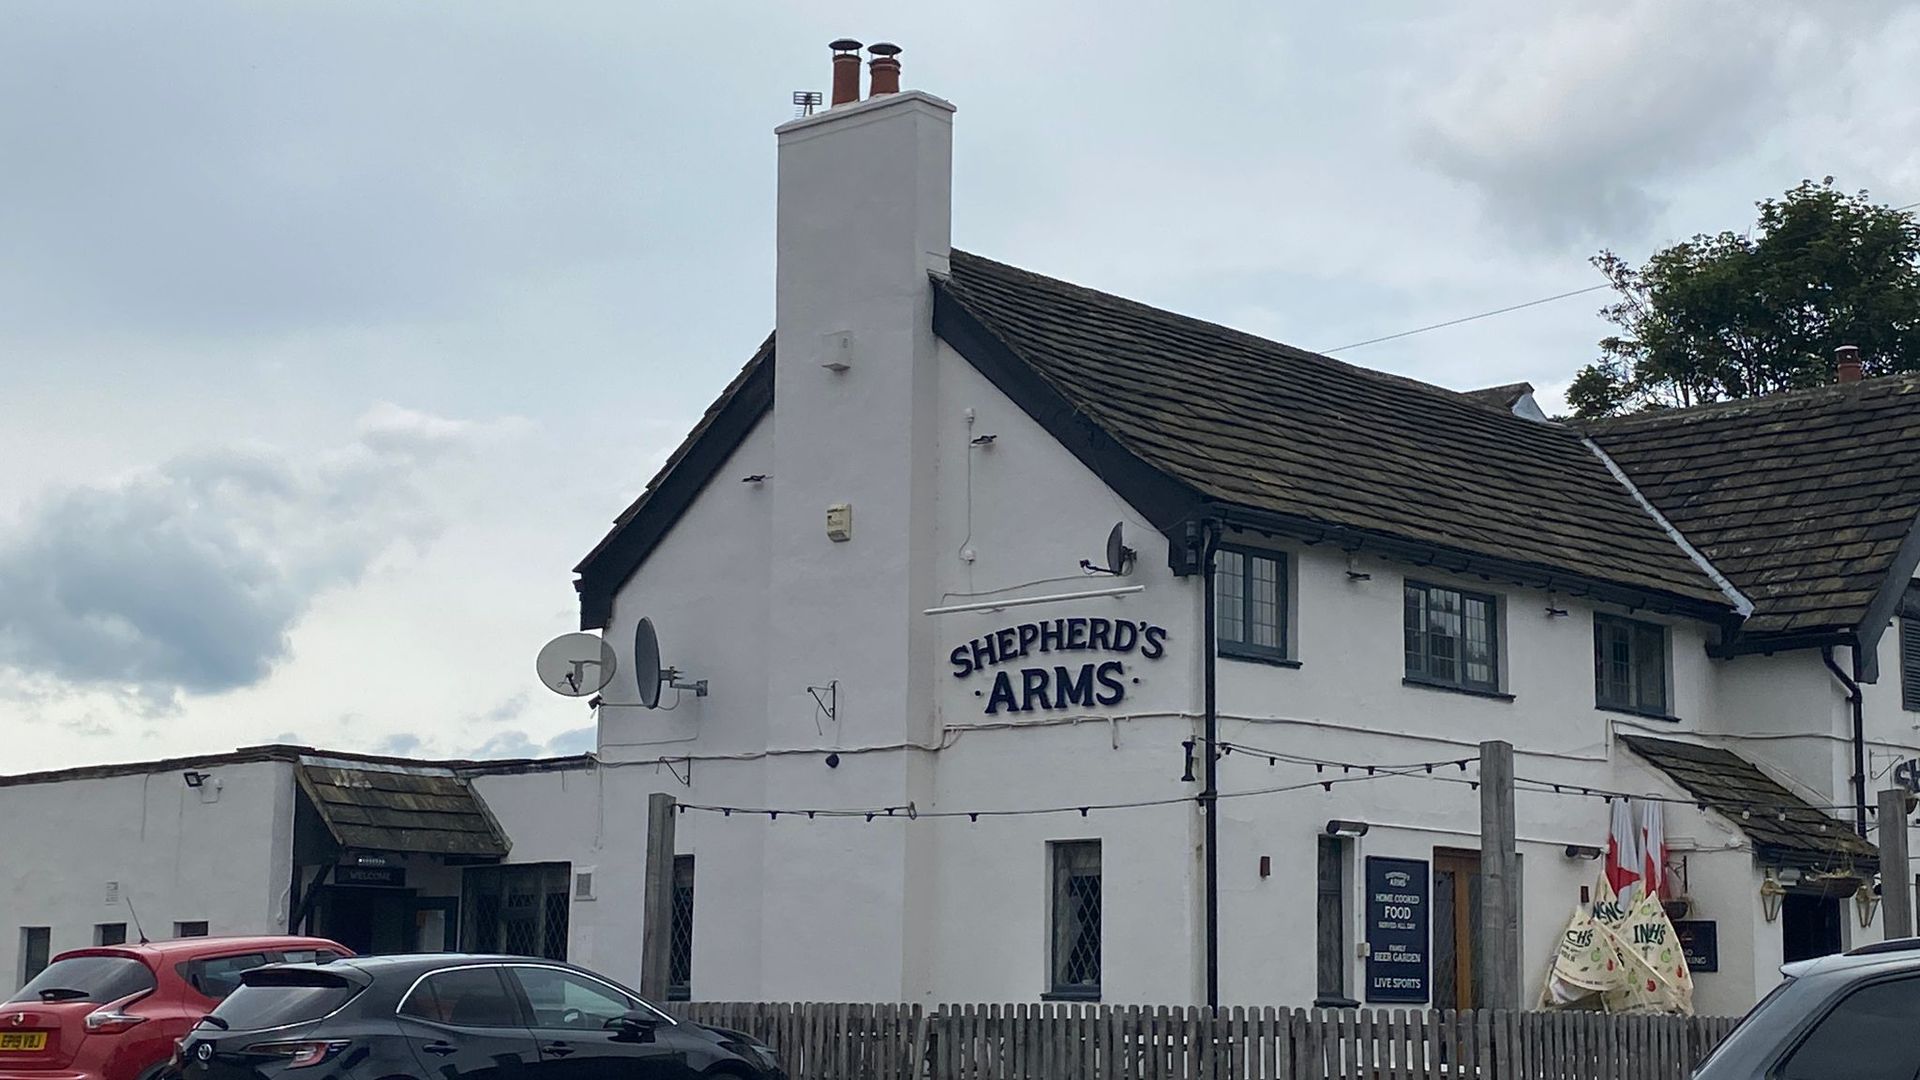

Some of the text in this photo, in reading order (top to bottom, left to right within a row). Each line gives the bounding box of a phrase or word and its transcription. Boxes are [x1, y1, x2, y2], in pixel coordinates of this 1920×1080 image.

[950, 618, 1167, 678] SHEPHERD'S
[984, 661, 1125, 714] ARMS
[350, 870, 391, 880] WELCOME
[1375, 893, 1420, 904] HOME COOKED
[1384, 906, 1411, 919] FOOD
[1374, 952, 1421, 962] BEER GARDEN
[1374, 977, 1421, 988] LIVE SPORTS
